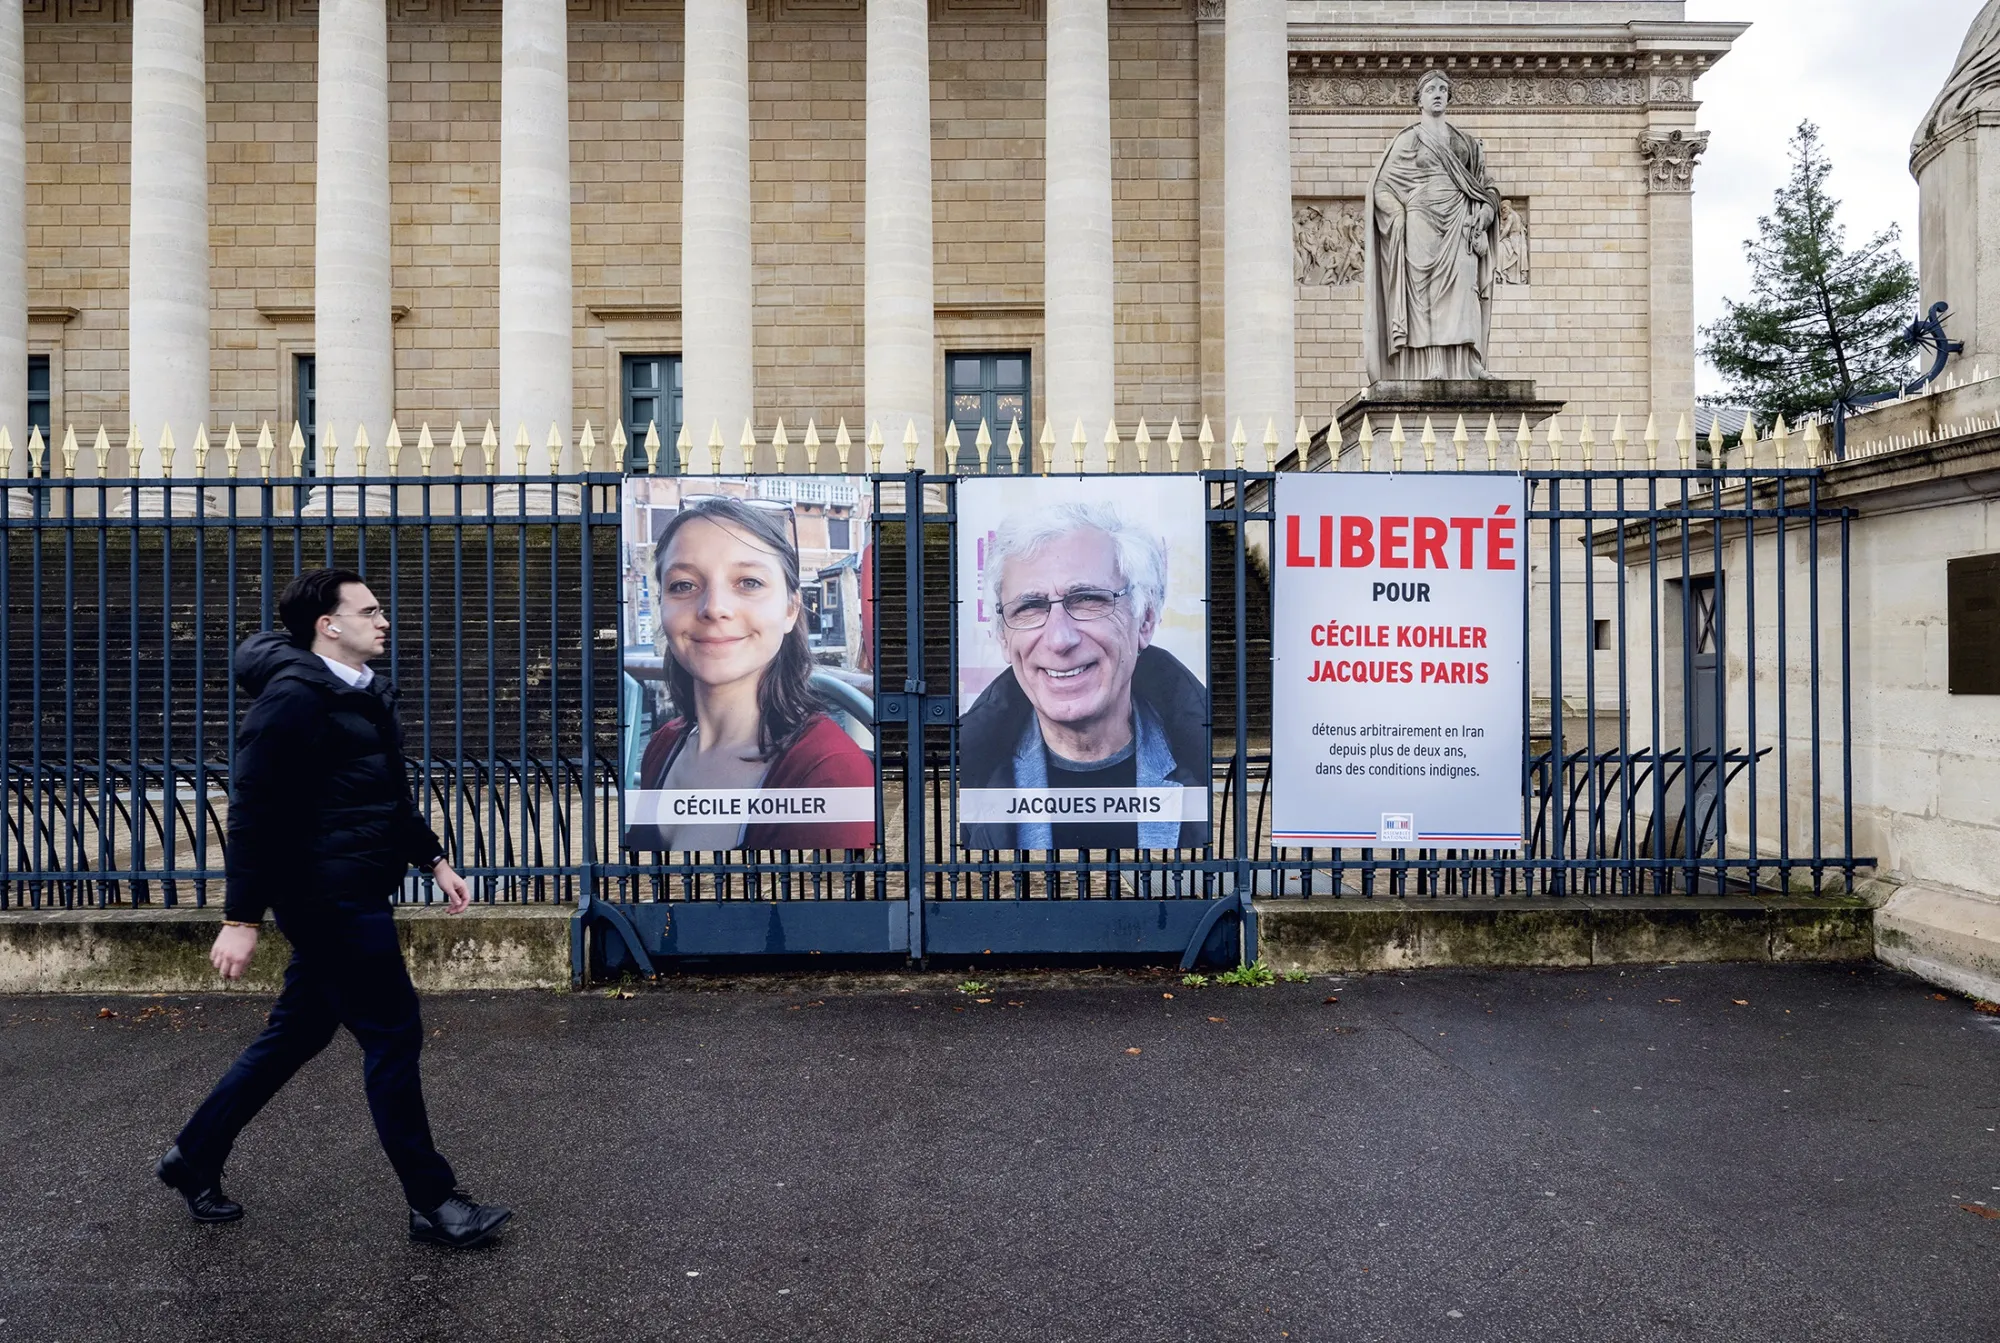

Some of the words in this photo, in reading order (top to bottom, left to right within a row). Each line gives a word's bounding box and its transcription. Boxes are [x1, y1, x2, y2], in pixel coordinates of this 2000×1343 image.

[1285, 504, 1517, 571] LIBERTÉ
[1372, 582, 1431, 603] POUR
[1310, 619, 1390, 648] CÉCILE
[1396, 625, 1488, 649] KOHLER
[1307, 660, 1414, 684] JACQUES
[1420, 661, 1489, 685] PARIS
[1311, 722, 1357, 737] détenus
[1359, 723, 1442, 738] arbitrairement
[1444, 727, 1459, 738] en
[1462, 724, 1484, 738] Iran
[1329, 742, 1367, 759] depuis
[1369, 743, 1394, 759] plus
[1396, 743, 1411, 757] de
[1413, 743, 1441, 757] deux
[1443, 746, 1467, 759] ans,
[1315, 761, 1343, 775] dans
[1345, 762, 1366, 776] des
[1368, 762, 1426, 776] conditions
[1429, 763, 1480, 780] indignes.
[673, 795, 741, 816] CÉCILE
[747, 797, 826, 815] KOHLER
[1006, 797, 1097, 814] JACQUES
[1103, 796, 1161, 813] PARIS
